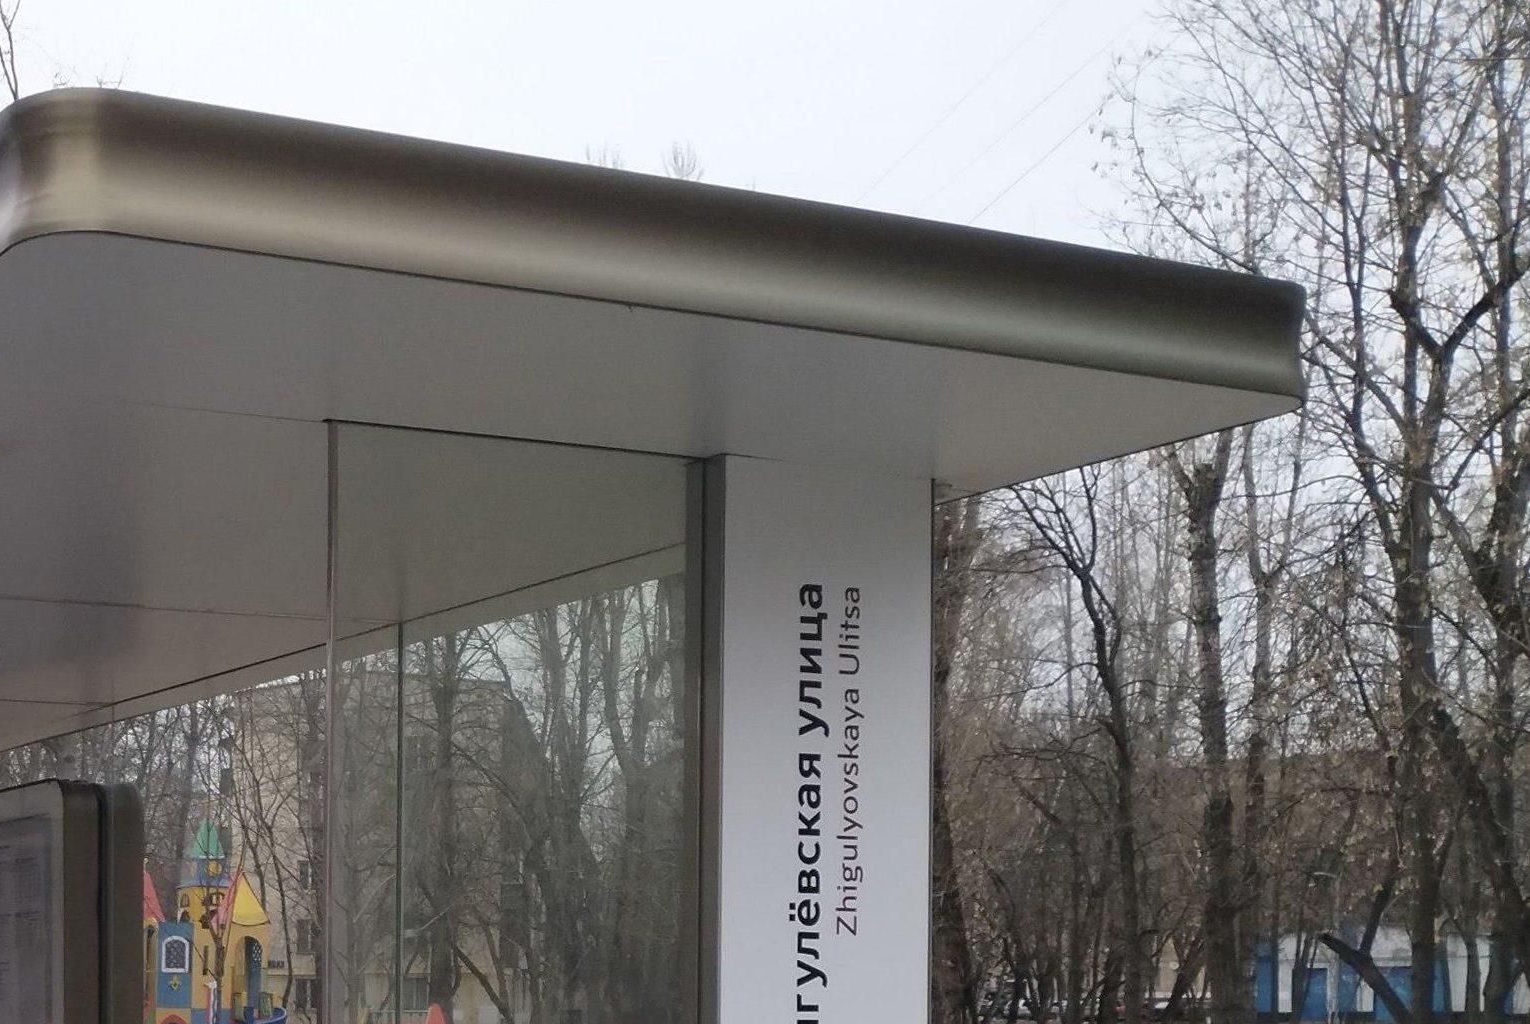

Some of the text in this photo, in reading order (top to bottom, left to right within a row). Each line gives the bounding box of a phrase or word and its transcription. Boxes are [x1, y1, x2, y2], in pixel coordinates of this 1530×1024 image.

[795, 582, 831, 740] улица
[835, 585, 866, 937] Zhigulyovskaya Ulitsa
